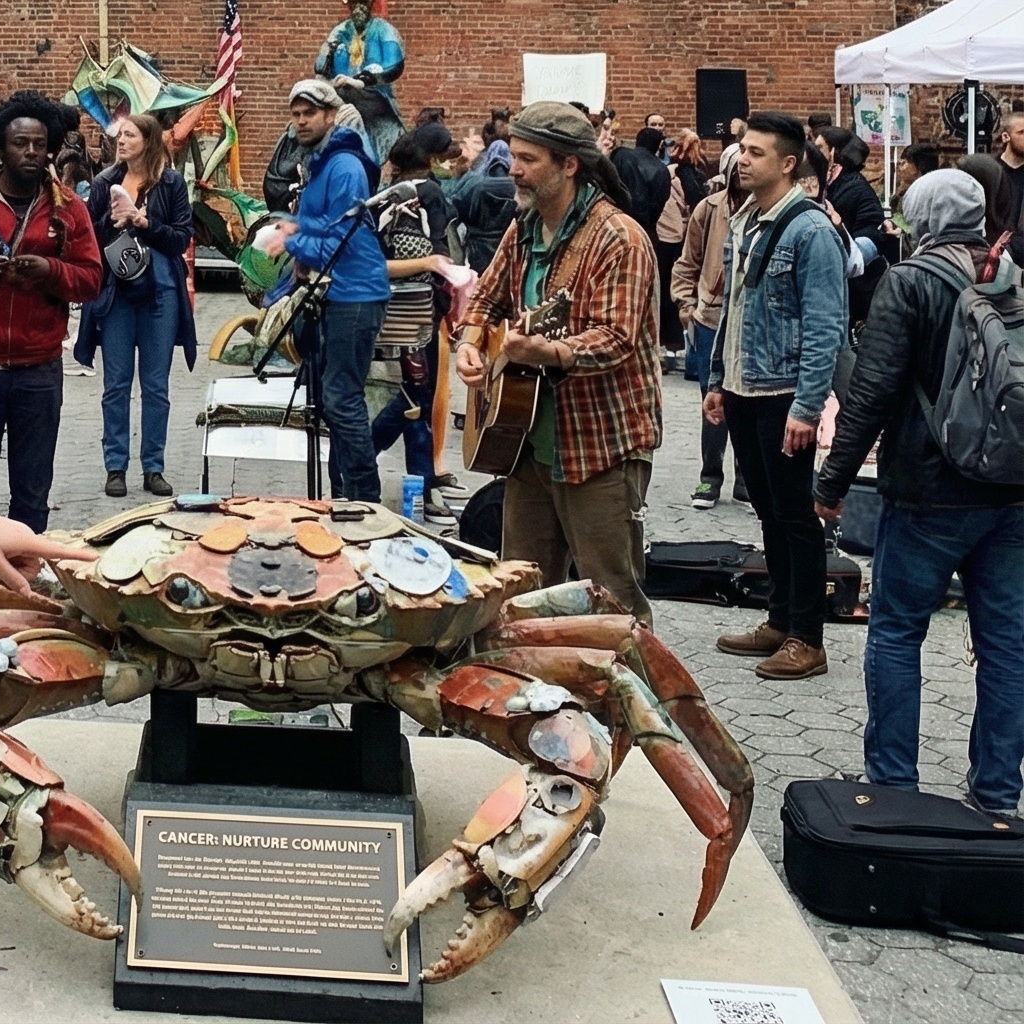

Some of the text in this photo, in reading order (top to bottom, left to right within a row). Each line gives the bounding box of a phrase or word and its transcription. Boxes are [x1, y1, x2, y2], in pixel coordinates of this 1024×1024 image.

[158, 831, 382, 854] CANCER: NURTURE COMMUNITY
